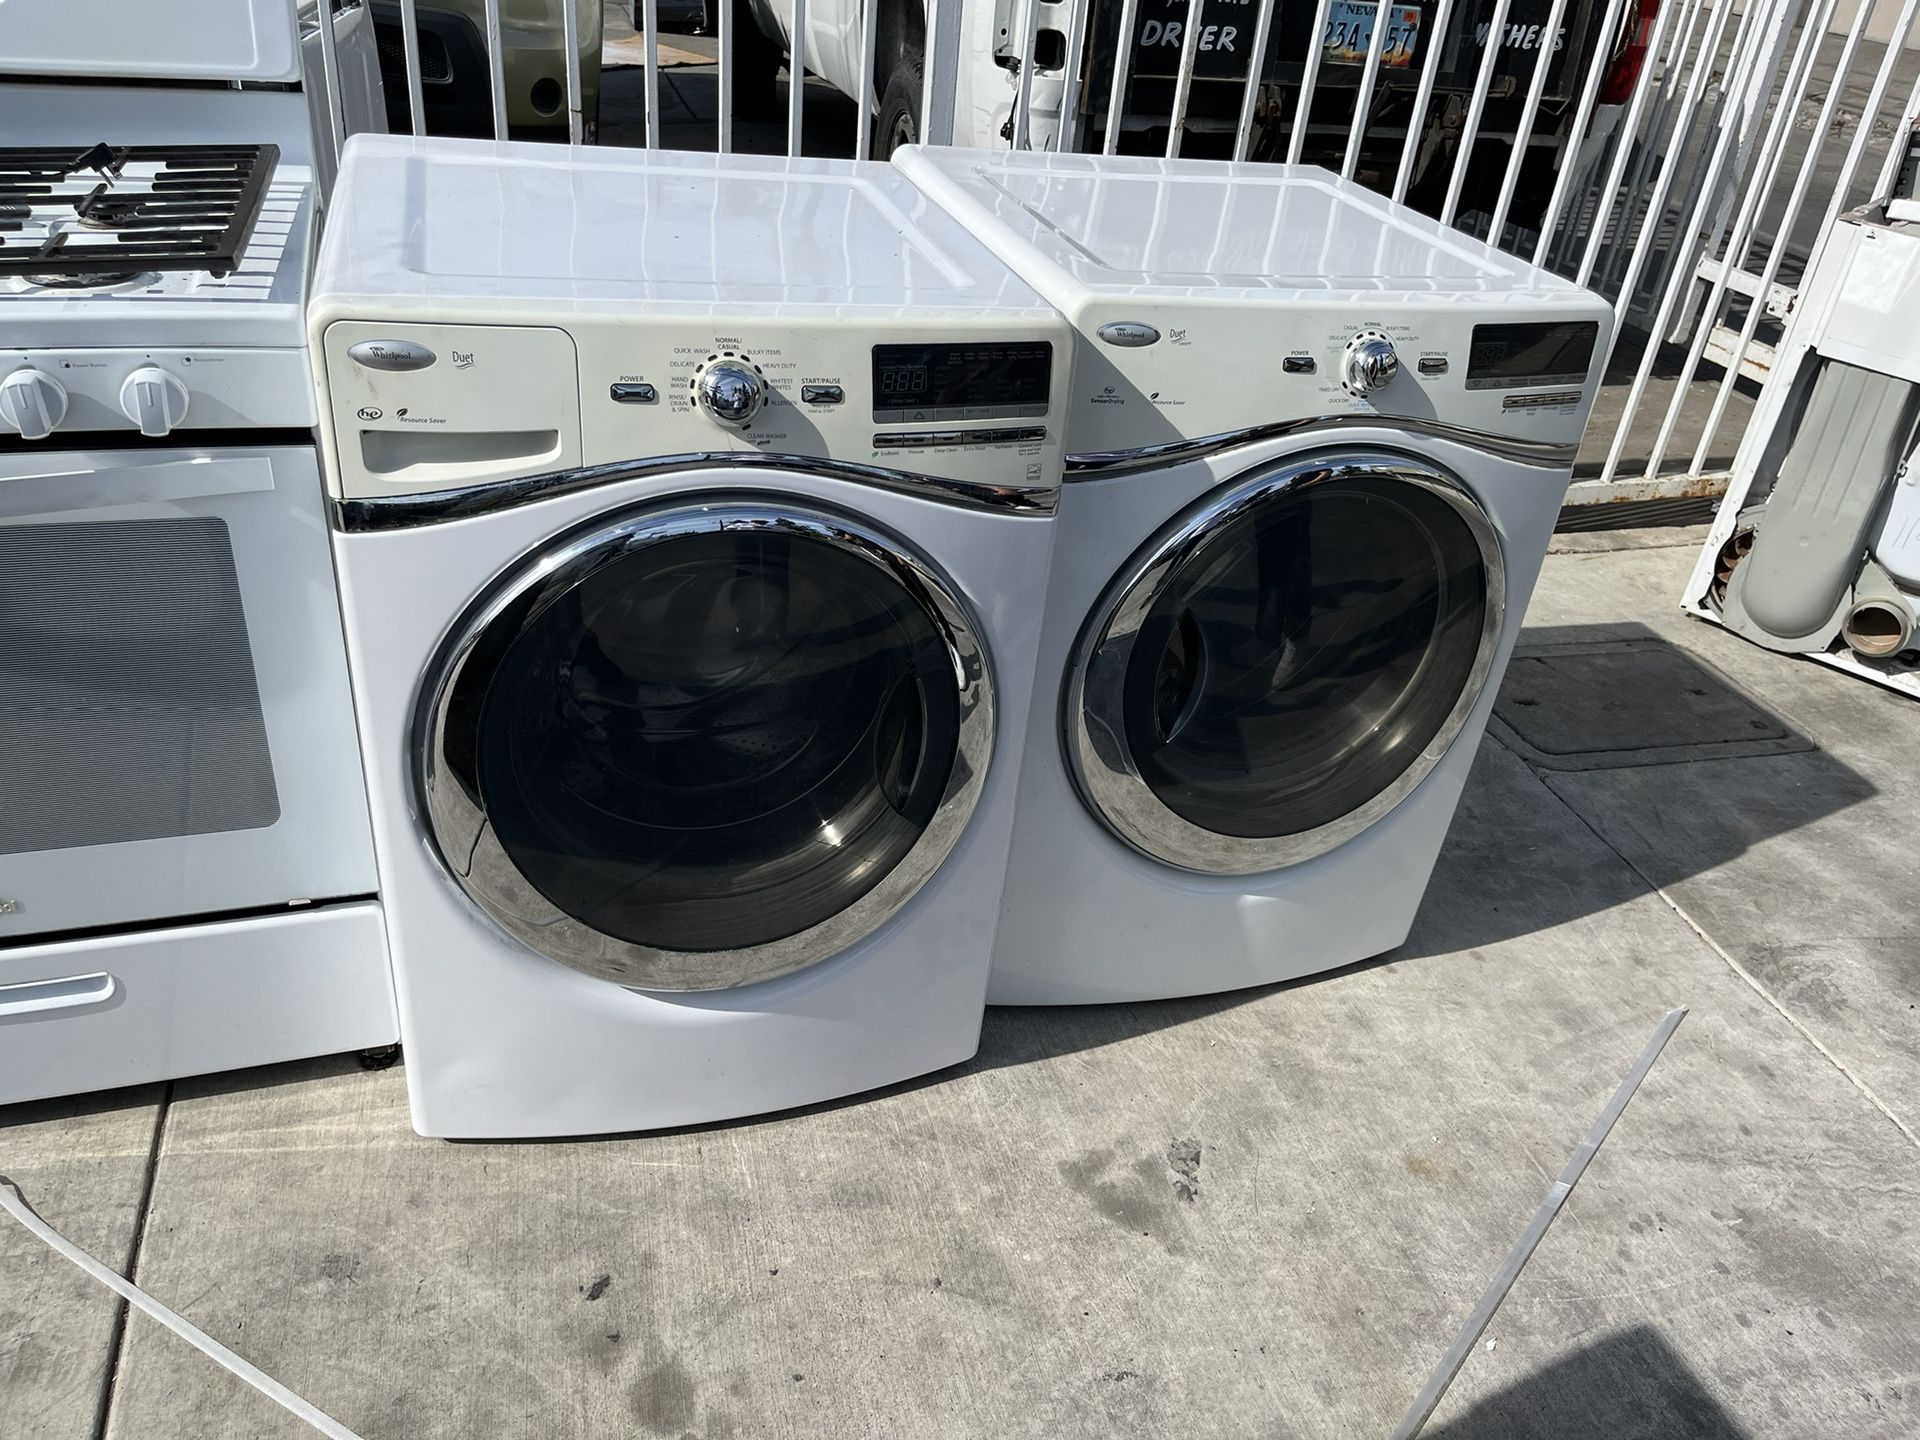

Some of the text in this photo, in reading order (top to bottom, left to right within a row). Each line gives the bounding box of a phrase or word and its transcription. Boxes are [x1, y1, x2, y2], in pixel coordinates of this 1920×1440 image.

[1345, 4, 1395, 18] NEVA
[1140, 19, 1238, 52] DRER
[1475, 22, 1566, 51] WSHES
[372, 351, 412, 361] Whirlpool
[452, 351, 475, 363] Duet
[619, 375, 645, 383] POWER
[400, 416, 428, 424] Resource
